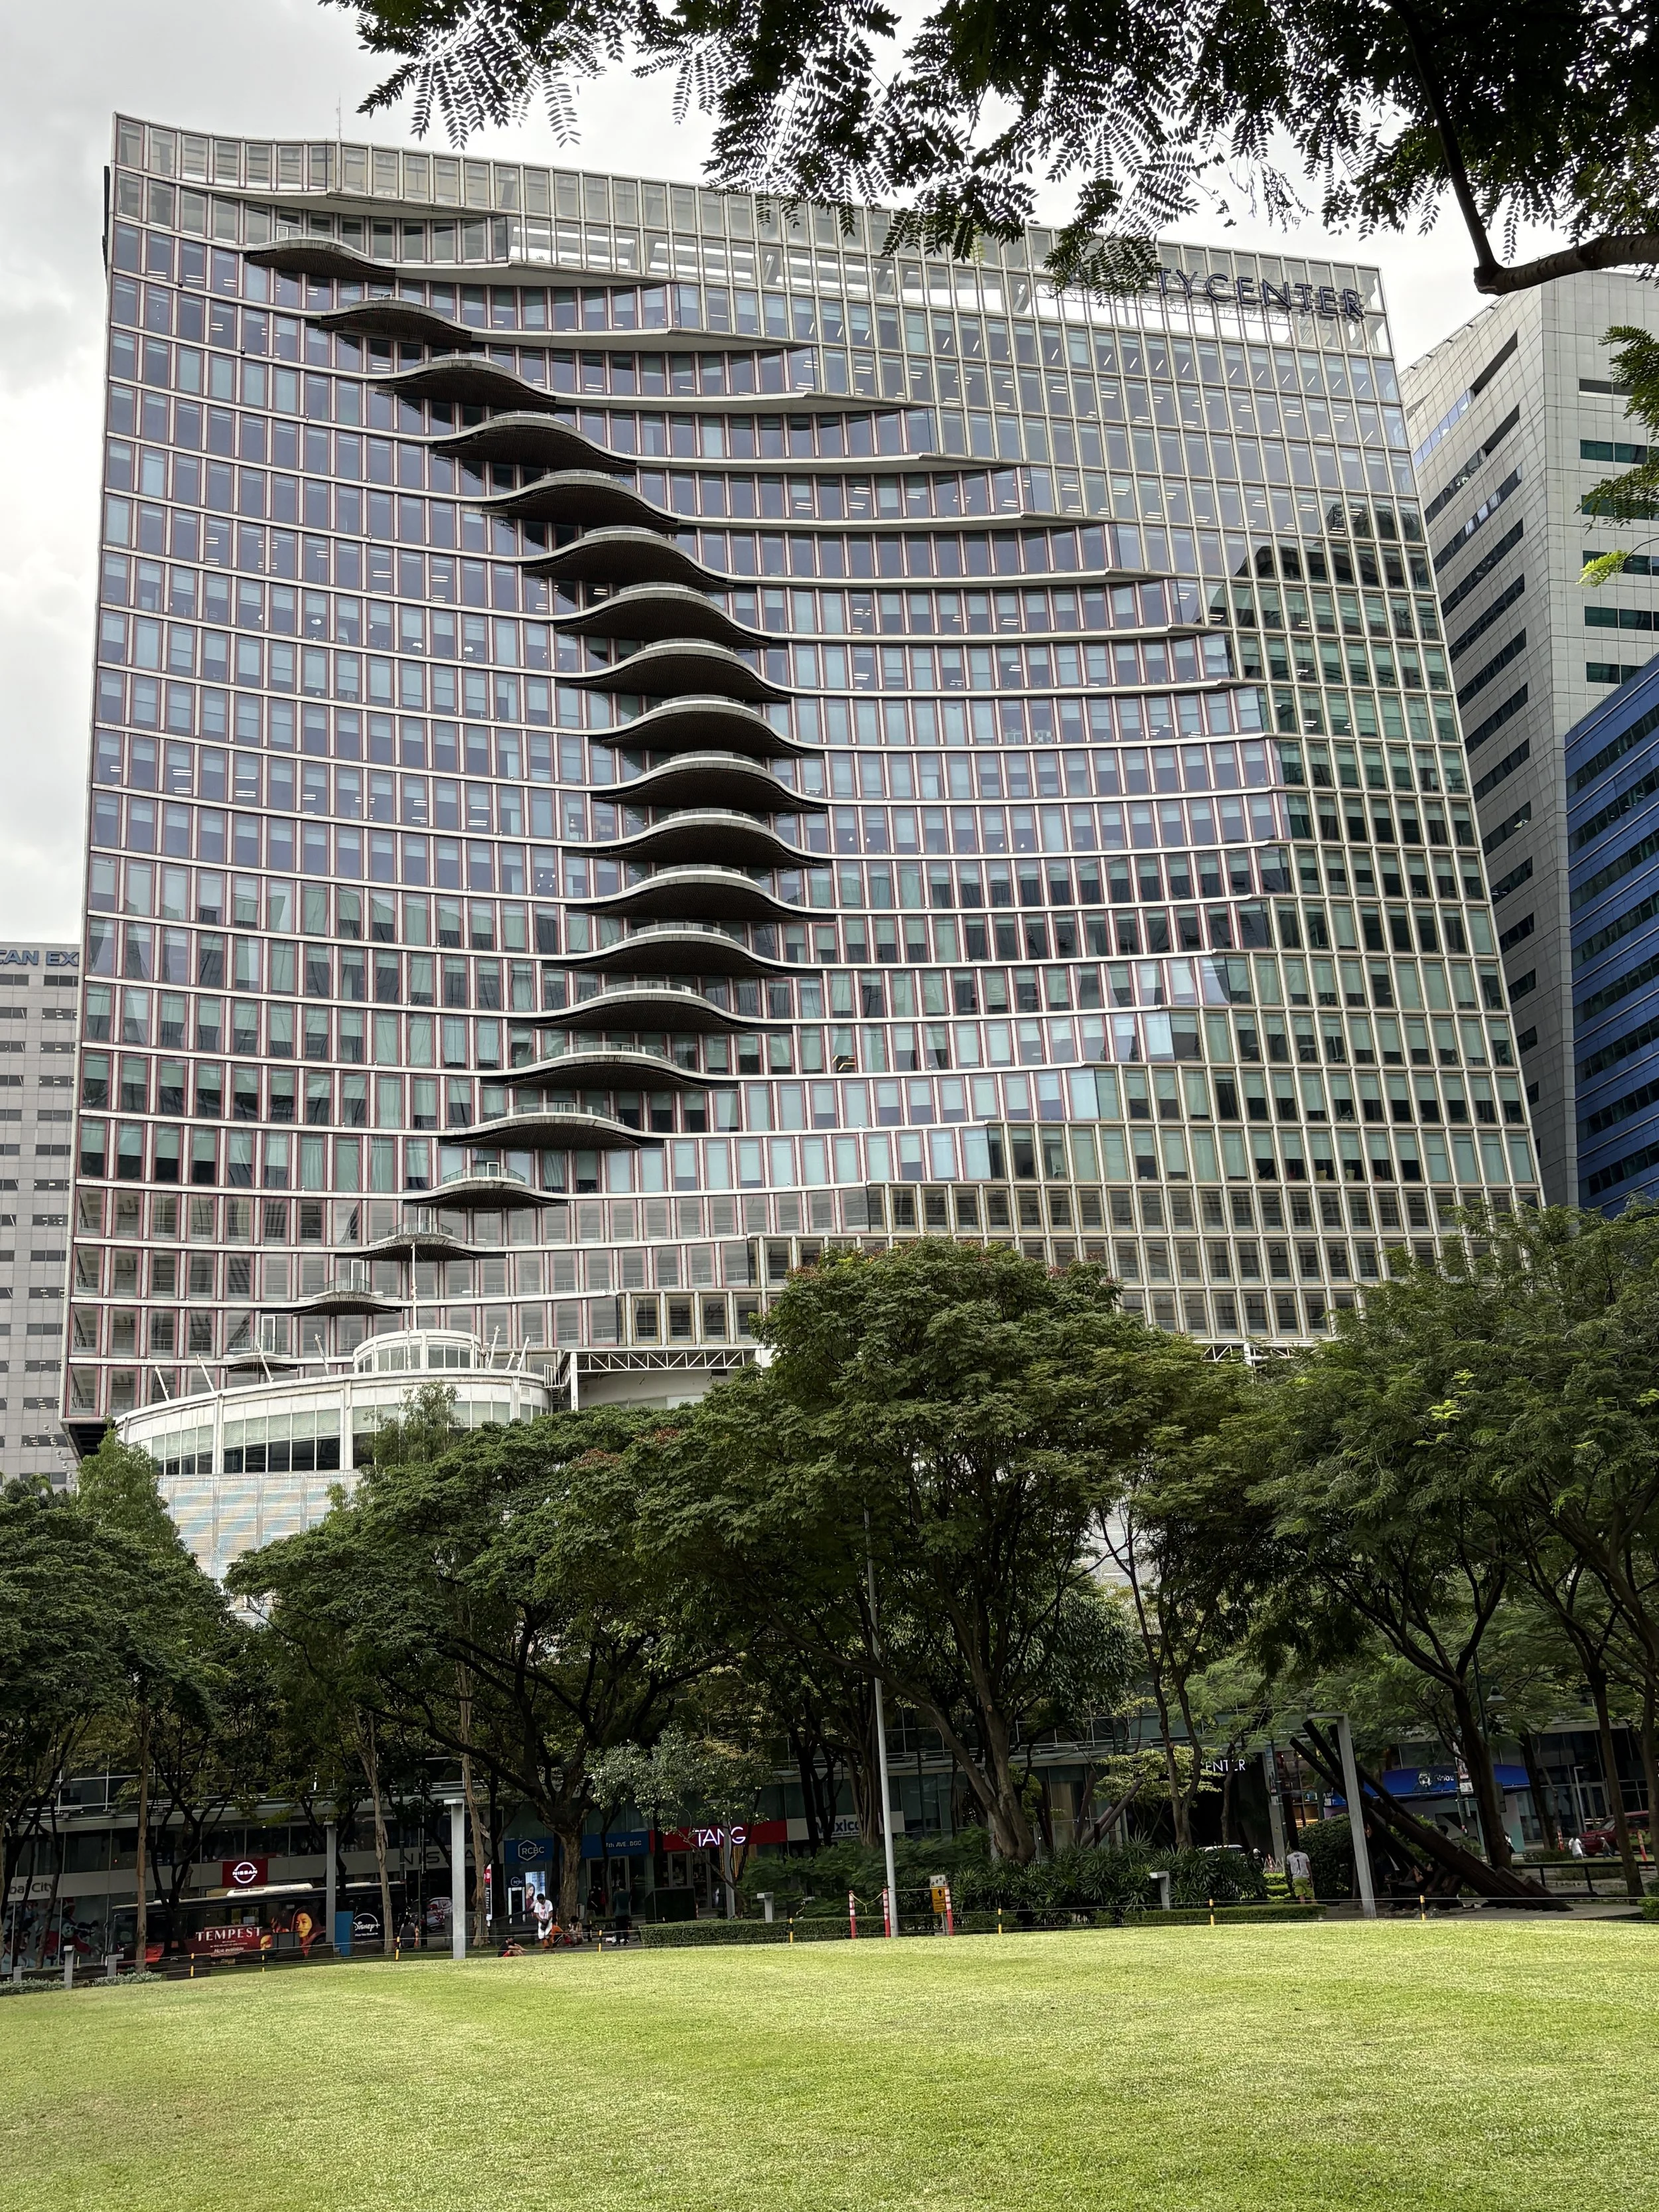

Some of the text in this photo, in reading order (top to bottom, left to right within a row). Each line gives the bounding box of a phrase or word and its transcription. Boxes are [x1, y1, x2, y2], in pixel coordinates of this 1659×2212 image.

[1143, 267, 1364, 318] TYCENTER
[46, 951, 79, 966] EX
[1206, 1759, 1246, 1771] ENTR
[692, 1826, 746, 1847] TANG
[401, 1849, 492, 1865] NSA
[522, 1846, 545, 1855] RCBC
[196, 1927, 263, 1942] TEMPEST
